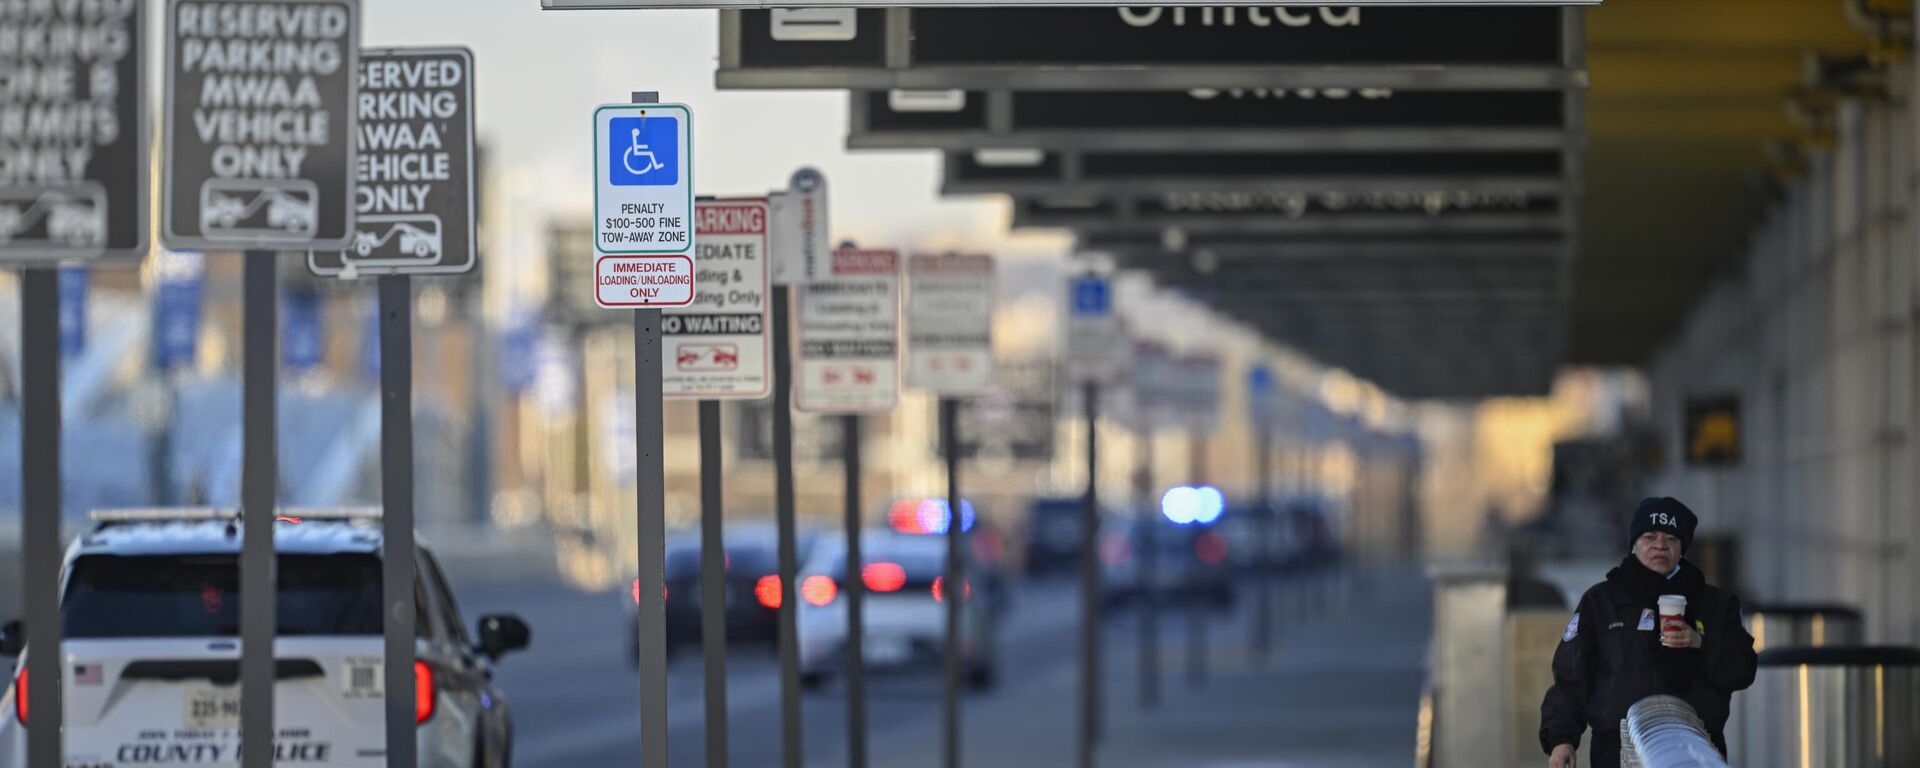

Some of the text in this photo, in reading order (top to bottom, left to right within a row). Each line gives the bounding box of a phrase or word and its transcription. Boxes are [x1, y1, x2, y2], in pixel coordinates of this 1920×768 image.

[178, 3, 348, 39] RESERVED
[182, 38, 342, 75] PARKING
[201, 73, 321, 108] MWAA
[193, 108, 330, 145] VEHICLE
[211, 144, 306, 178] ONLY
[622, 203, 664, 214] PENALTY
[606, 217, 681, 229] $100-500 FINE
[602, 231, 686, 243] TOW-AWAY ZONE
[613, 263, 676, 273] IMMEDIATE
[600, 275, 690, 285] LOADING/UNLOADING
[630, 288, 659, 298] ONLY
[728, 290, 761, 307] Only
[685, 315, 761, 333] WAITING
[1650, 513, 1677, 528] TSA
[116, 742, 331, 764] COUNTY LICE
